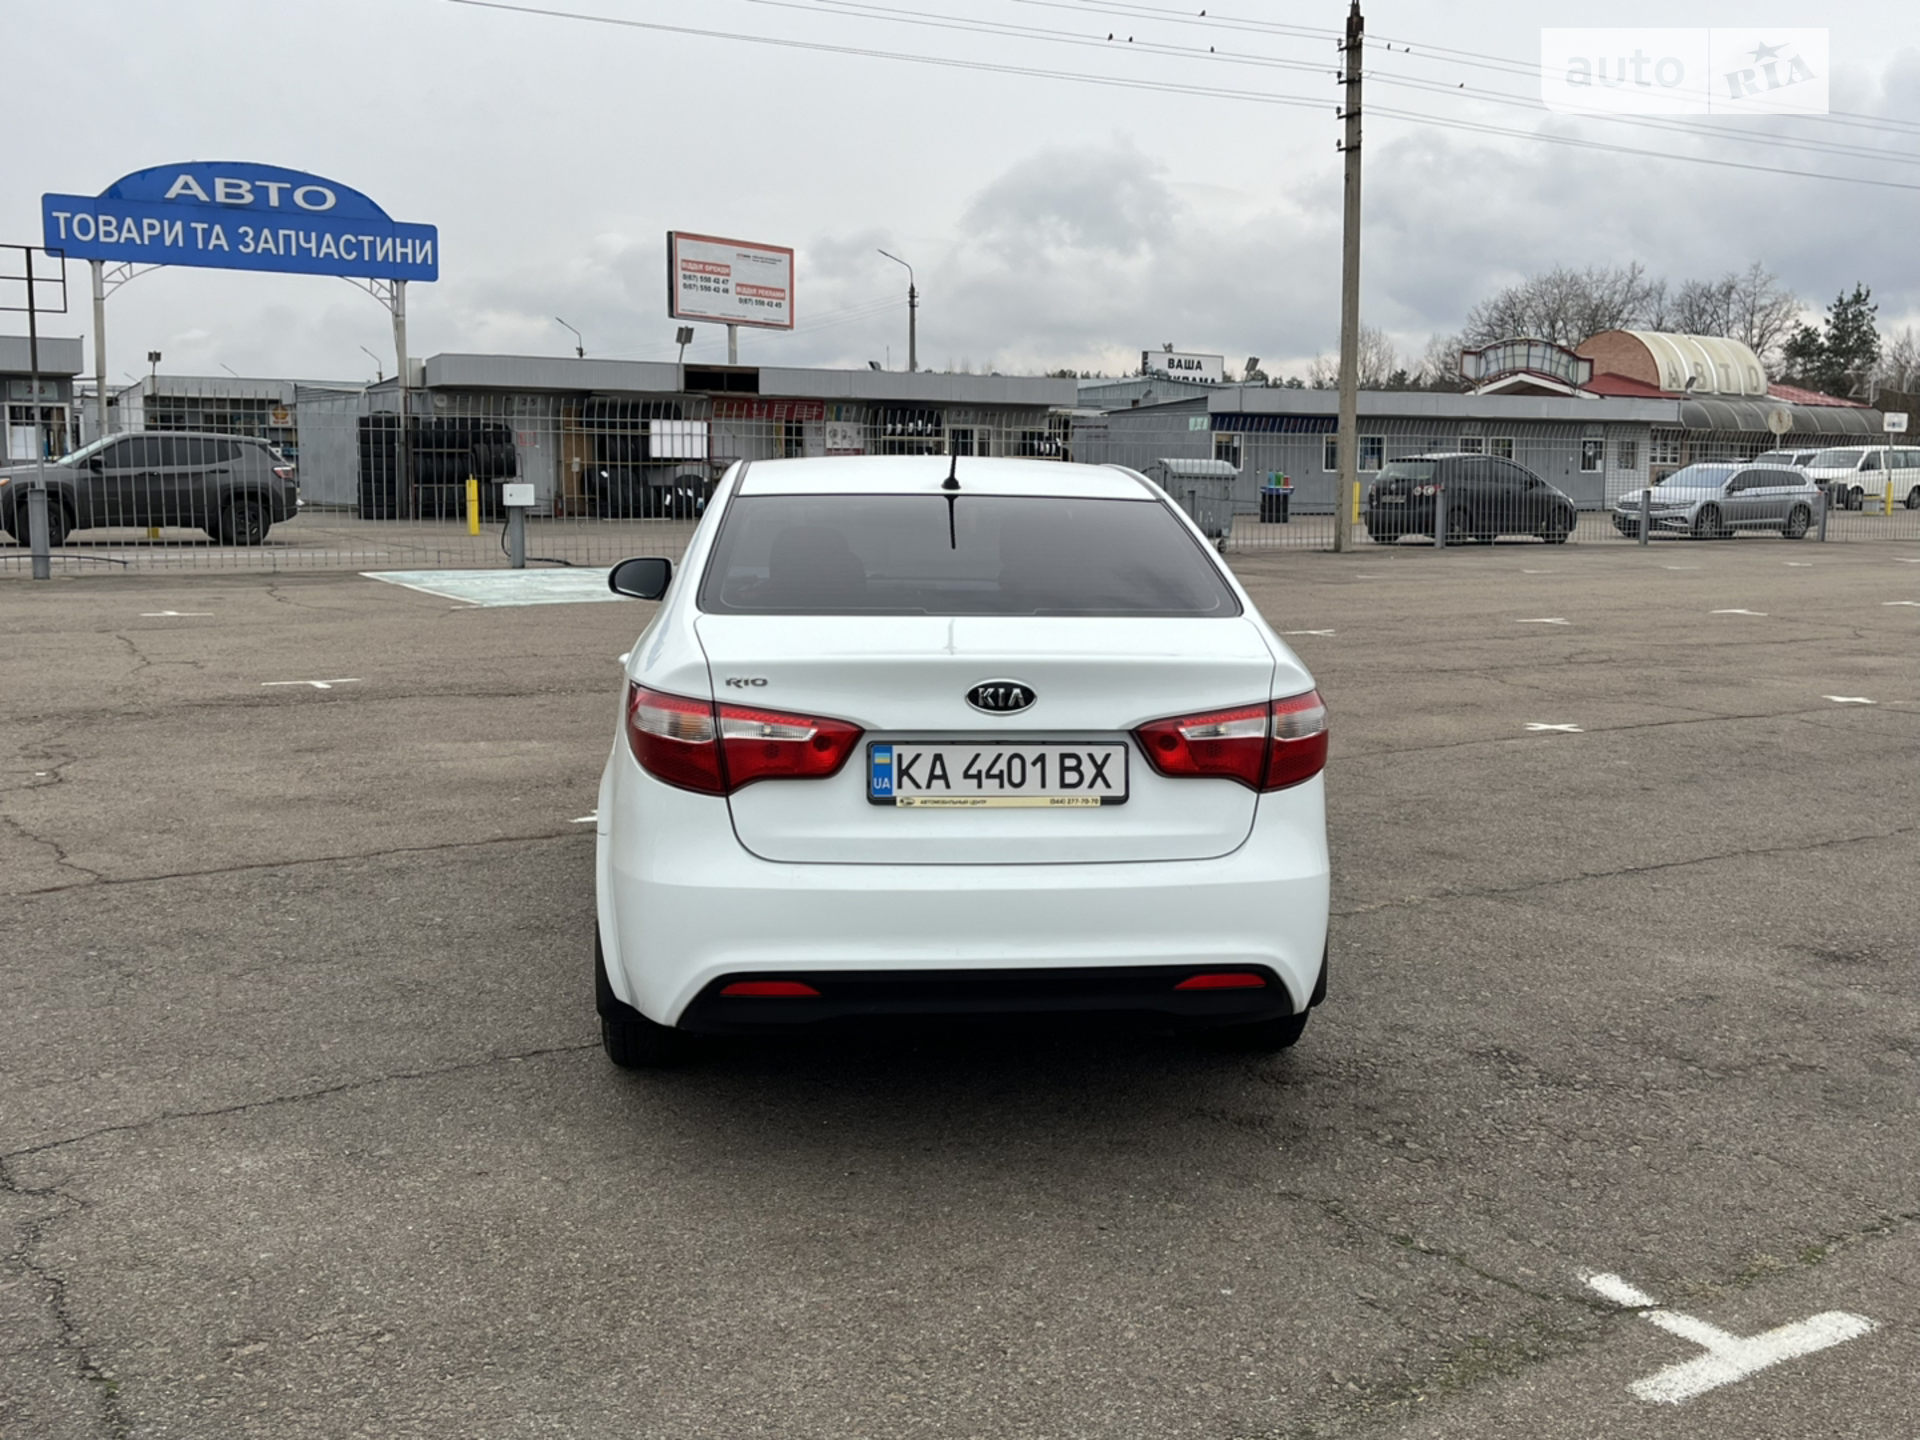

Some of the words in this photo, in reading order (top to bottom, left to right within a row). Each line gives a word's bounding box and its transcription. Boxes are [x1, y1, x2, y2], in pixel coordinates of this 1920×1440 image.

[164, 174, 337, 212] АВТО
[51, 211, 184, 248] ТОВАРИ
[190, 222, 230, 252] ТА
[238, 226, 433, 265] ЗАПЧАСТИНИ
[682, 273, 699, 283] 0(67)
[700, 275, 711, 283] 550
[713, 276, 721, 284] 42
[682, 282, 698, 292] 0(67)
[700, 284, 711, 292] 550
[713, 285, 721, 293] 42
[738, 297, 754, 307] 0(67)
[754, 299, 766, 308] 550
[766, 300, 774, 308] 42
[1168, 358, 1203, 370] ВАША
[725, 677, 769, 688] RIO
[977, 687, 1026, 707] KIA
[896, 752, 951, 790] KA
[962, 752, 1047, 790] 4401
[1058, 752, 1112, 790] BX
[873, 777, 891, 789] UA
